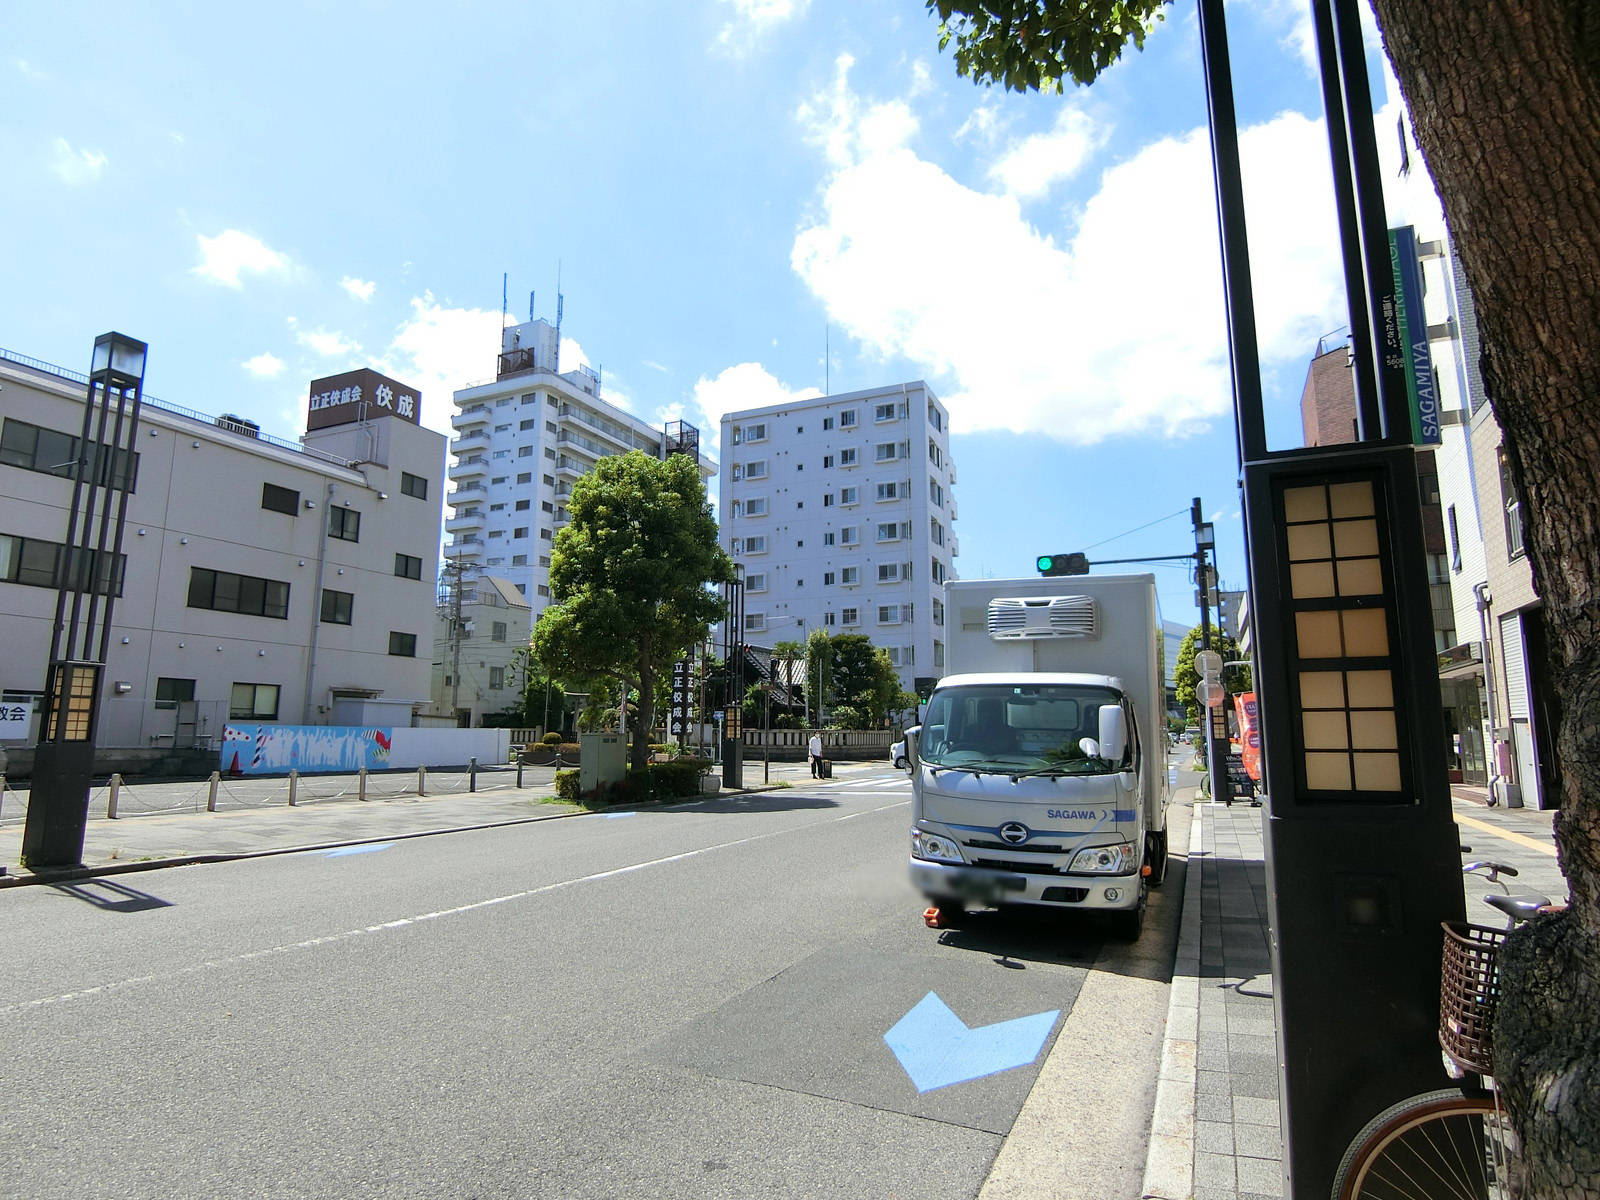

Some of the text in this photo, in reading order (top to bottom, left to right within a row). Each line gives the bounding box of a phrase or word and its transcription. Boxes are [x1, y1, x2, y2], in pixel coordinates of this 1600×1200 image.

[310, 385, 362, 411] 立正佼成会
[375, 383, 414, 419] 佼成
[1411, 340, 1438, 437] SAGAMIYA
[672, 661, 684, 733] 立正佼成会
[1047, 809, 1097, 820] SAGAWA
